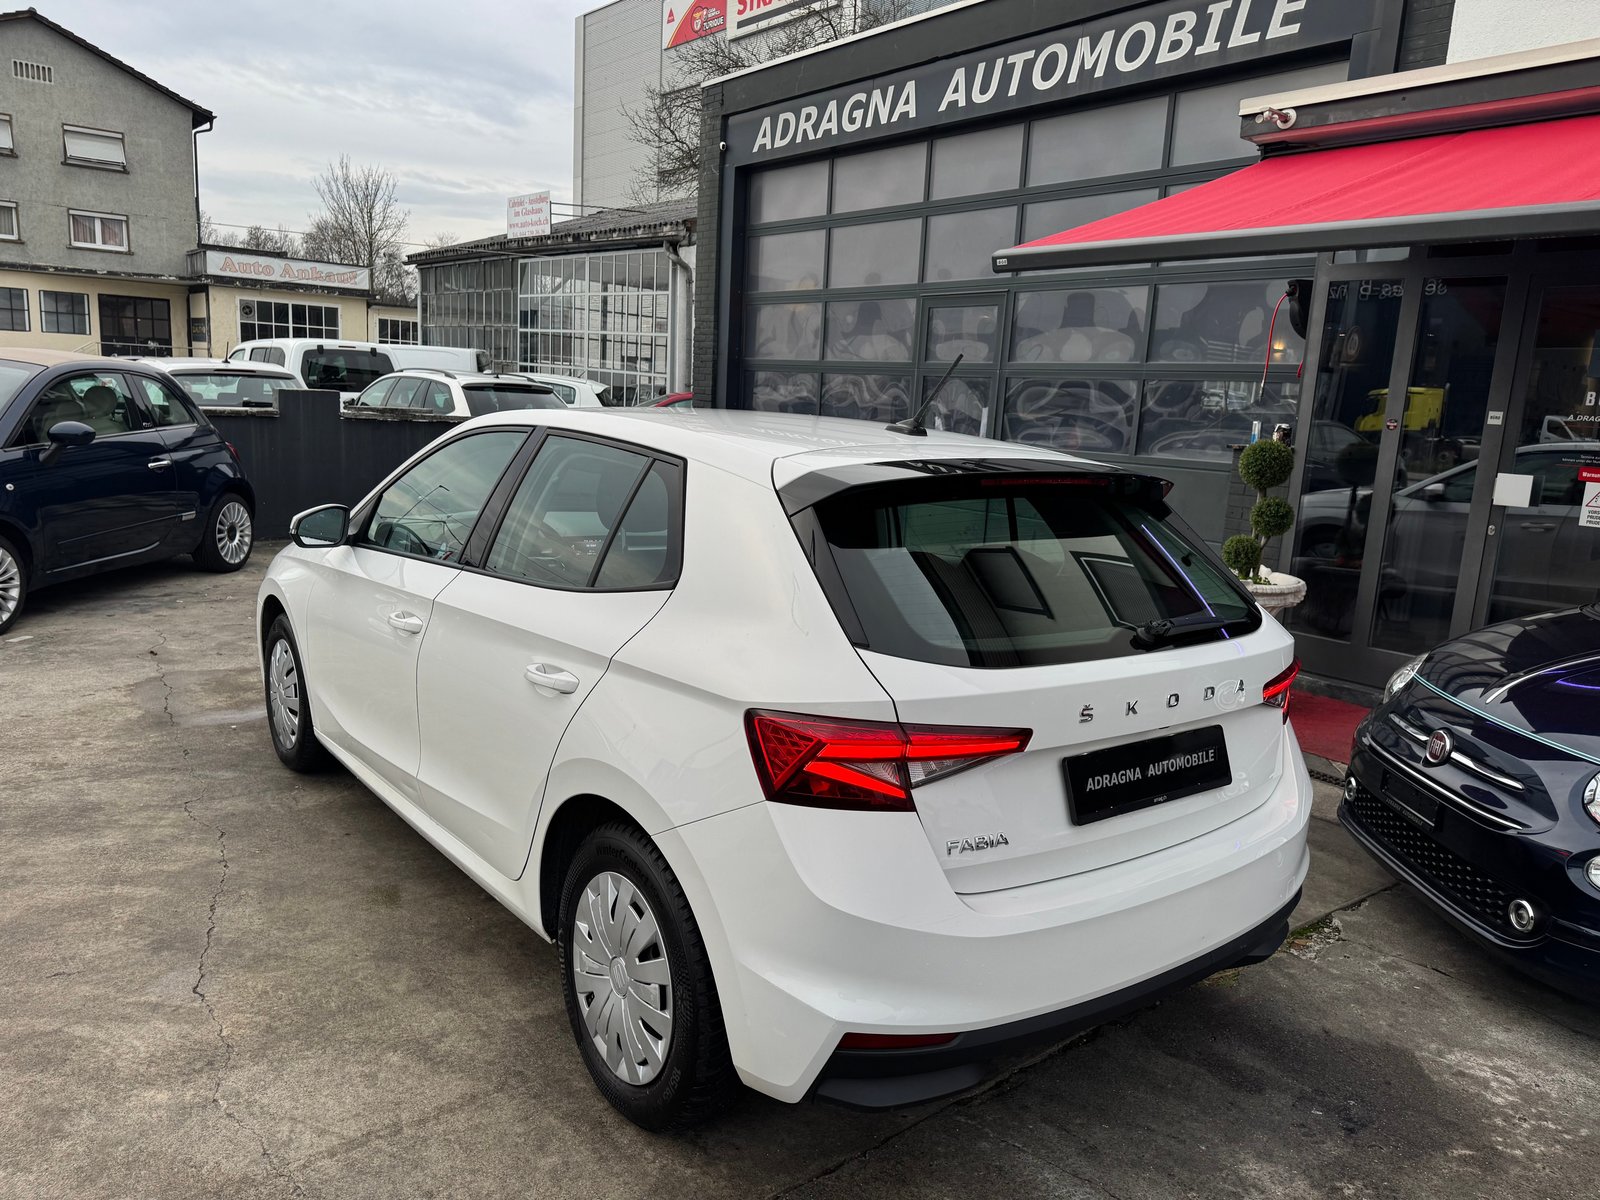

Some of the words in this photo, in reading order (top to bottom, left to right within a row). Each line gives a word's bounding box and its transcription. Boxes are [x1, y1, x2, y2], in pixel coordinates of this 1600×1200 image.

[753, 80, 917, 152] ADRAGNA
[938, 0, 1305, 112] AUTOMOBILE
[220, 256, 275, 277] Auto
[280, 263, 358, 286] Ankauf
[1079, 679, 1245, 723] ŠKODA
[1429, 738, 1445, 756] FIAT
[1086, 766, 1142, 792] ADRAGNA
[1147, 749, 1215, 777] AUTOMOBILE
[945, 831, 1009, 855] FABIA
